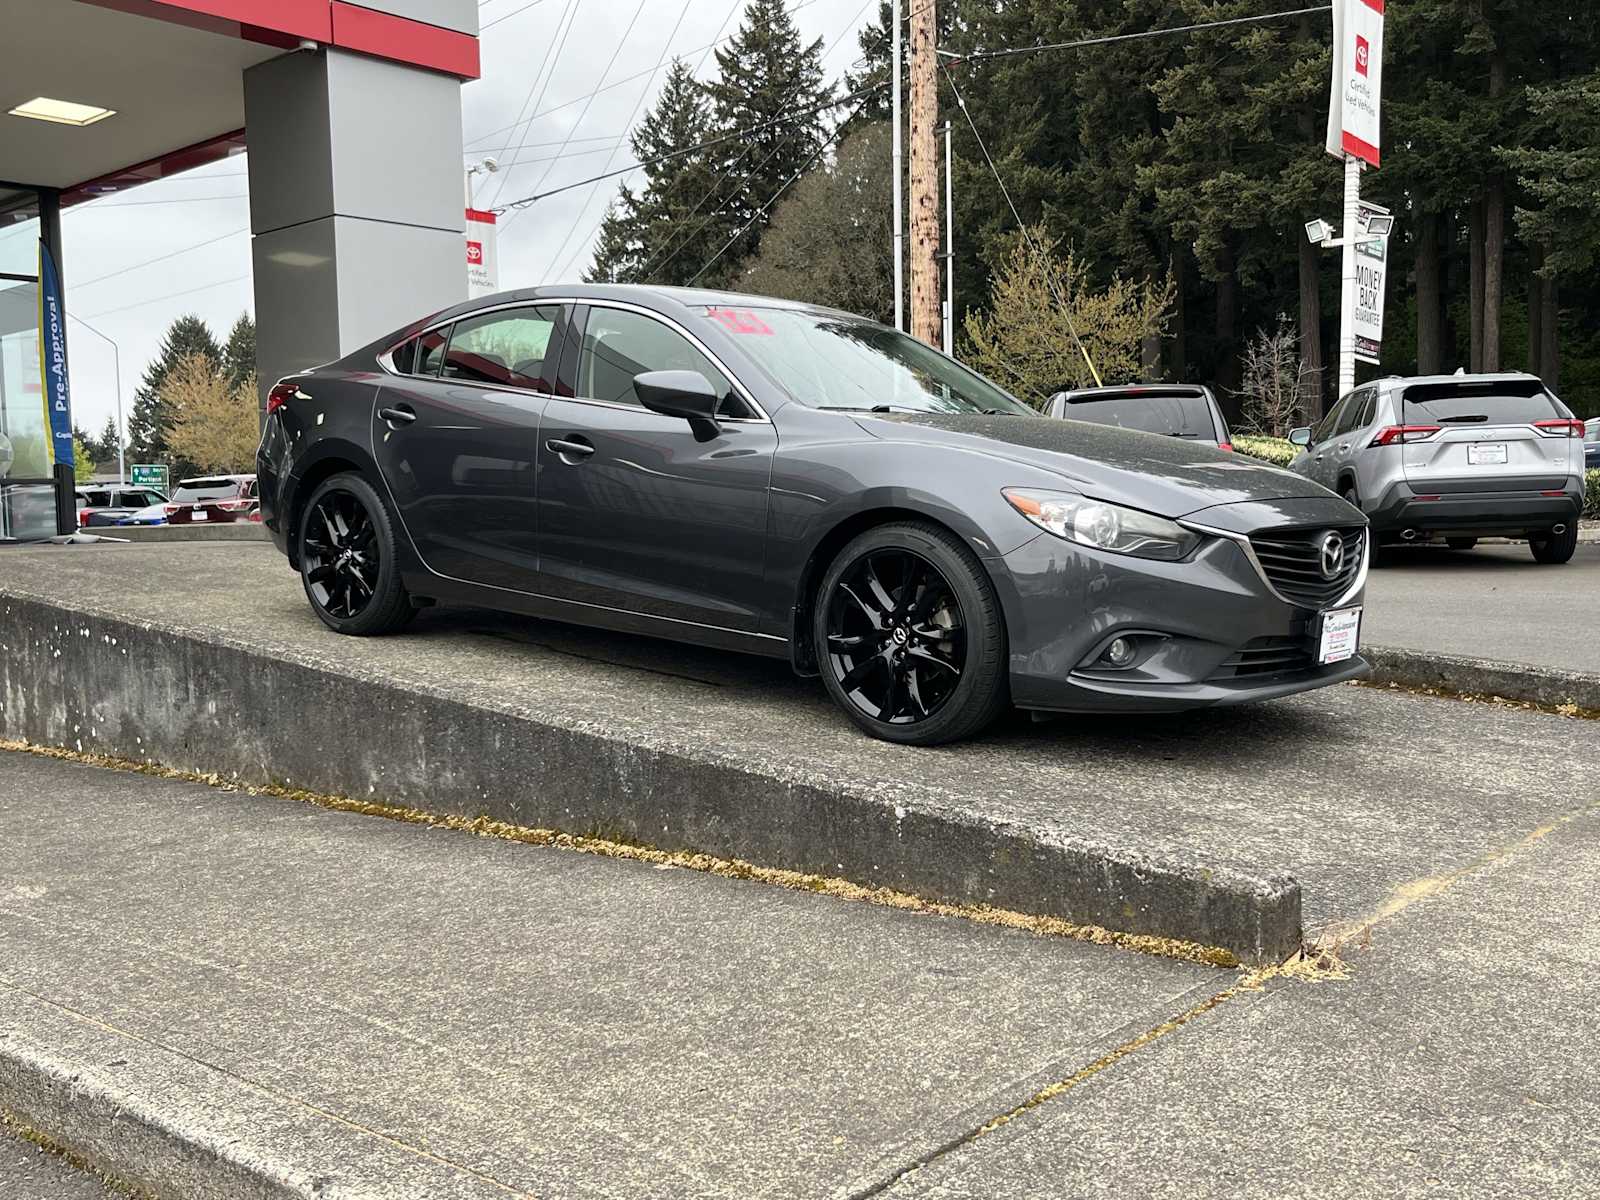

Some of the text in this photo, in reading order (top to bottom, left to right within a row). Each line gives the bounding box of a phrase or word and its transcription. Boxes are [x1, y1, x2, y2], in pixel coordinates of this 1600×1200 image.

[1355, 264, 1383, 291] MONEY
[1360, 286, 1378, 311] BACK
[1355, 306, 1380, 327] GUARANTEE
[47, 296, 67, 412] Pre-Approval
[138, 475, 162, 483] Portland
